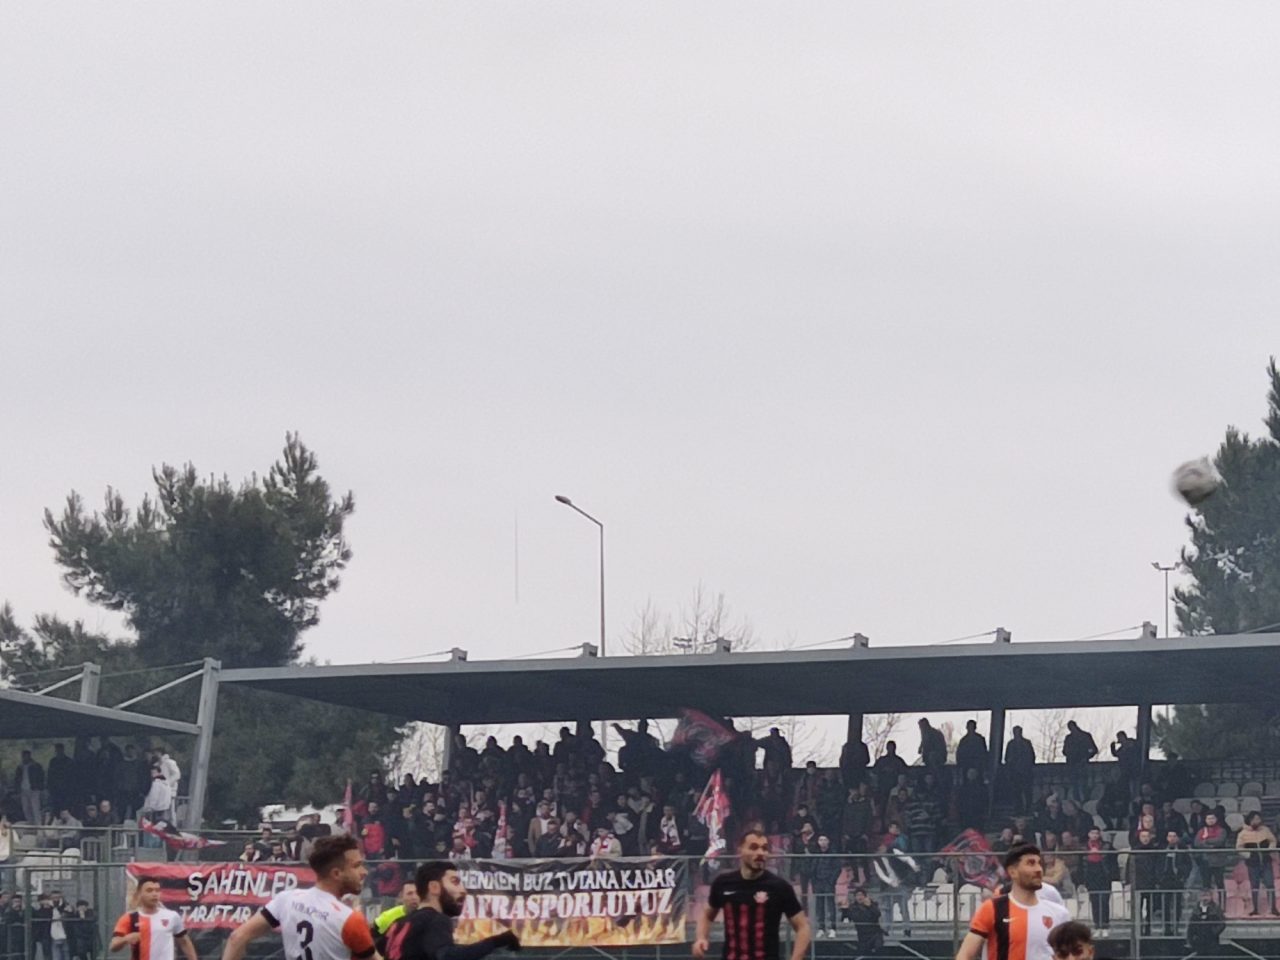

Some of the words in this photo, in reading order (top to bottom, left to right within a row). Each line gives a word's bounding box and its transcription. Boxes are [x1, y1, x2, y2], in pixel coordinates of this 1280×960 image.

[523, 871, 554, 891] BUZ
[555, 870, 620, 891] TUTANA
[620, 868, 676, 889] KADAR
[459, 888, 673, 919] AFRASPORLUYUZ
